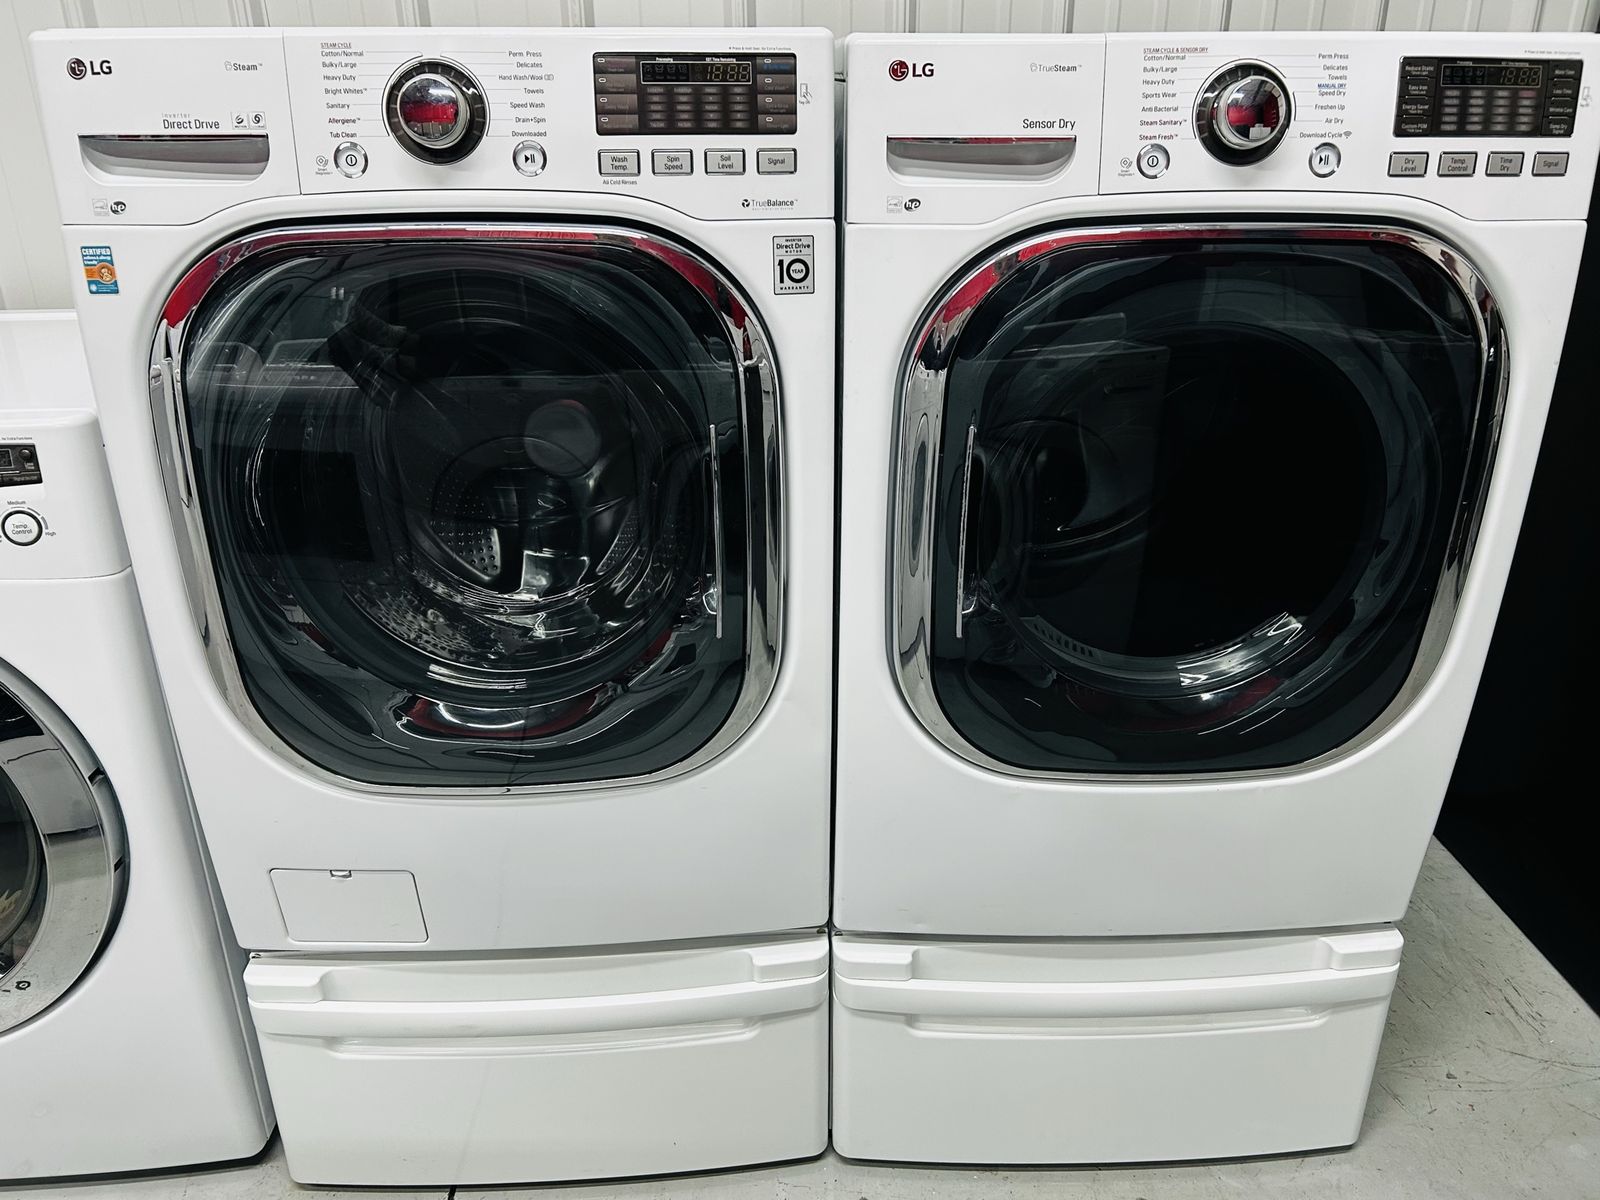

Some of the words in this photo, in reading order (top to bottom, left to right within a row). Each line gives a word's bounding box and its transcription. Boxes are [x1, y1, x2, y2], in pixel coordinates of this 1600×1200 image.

[89, 60, 112, 75] LG
[322, 61, 357, 69] Bulky/Large
[912, 62, 934, 77] LG
[323, 73, 341, 82] Heavy
[342, 73, 356, 81] Duty
[1161, 78, 1175, 86] Duty
[324, 87, 342, 95] Bright
[1141, 91, 1161, 99] Sports
[1318, 89, 1336, 97] Speed
[326, 102, 351, 110] Sanitary
[510, 101, 528, 109] Speed
[1141, 104, 1154, 112] Anti
[1154, 103, 1179, 112] Bacterial
[515, 116, 547, 124] Drain+Spin
[1140, 119, 1158, 127] Steam
[1334, 117, 1344, 125] Dry
[163, 119, 192, 129] Direct
[194, 119, 220, 130] Drive
[1022, 118, 1057, 129] Sensor
[1058, 118, 1076, 131] Dry
[329, 131, 340, 139] Tub
[340, 131, 358, 139] Clean
[511, 130, 547, 138] Downloaded
[1299, 131, 1327, 139] Download
[1328, 131, 1343, 139] Cycle
[610, 155, 629, 163] Wash
[666, 155, 680, 164] Spin
[719, 154, 732, 162] Soil
[767, 157, 786, 166] Signal
[1404, 157, 1415, 165] Dry
[1500, 156, 1513, 164] Time
[664, 163, 684, 172] Speed
[717, 162, 734, 170] Level
[1542, 160, 1560, 169] Signal
[1447, 165, 1469, 173] Control
[1500, 165, 1510, 173] Dry
[795, 242, 811, 250] Drive
[777, 258, 810, 284] 10
